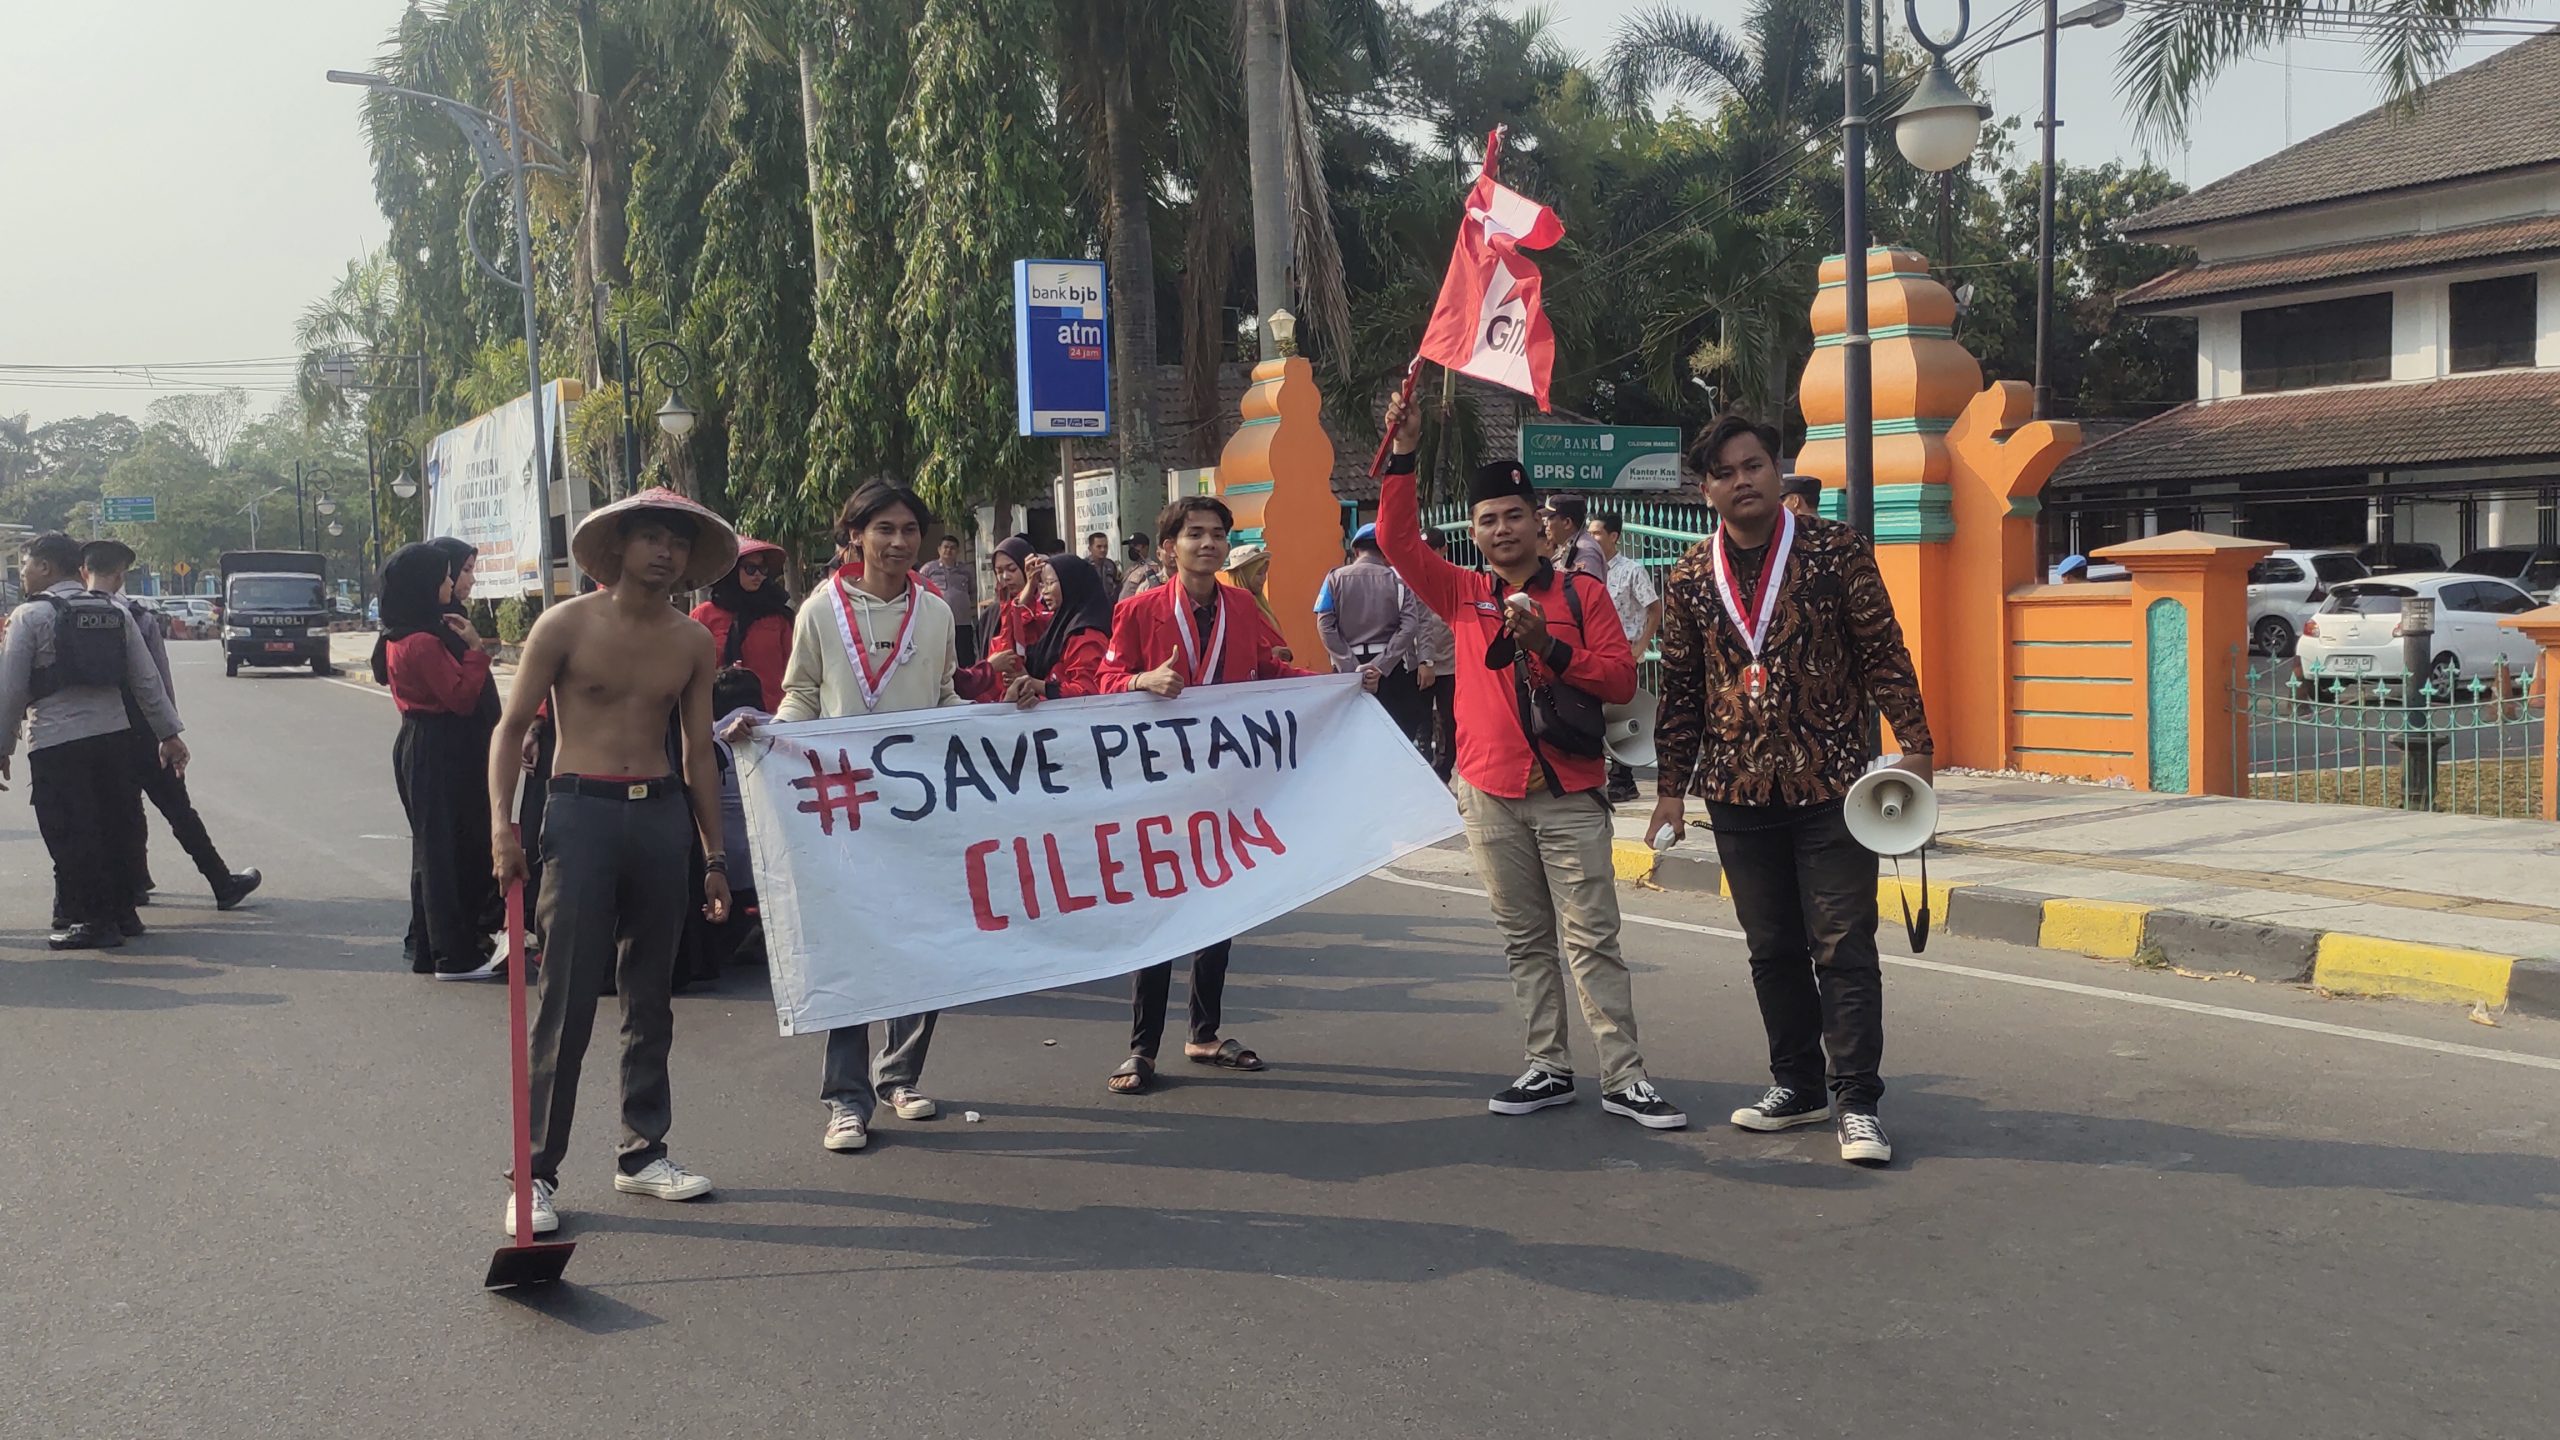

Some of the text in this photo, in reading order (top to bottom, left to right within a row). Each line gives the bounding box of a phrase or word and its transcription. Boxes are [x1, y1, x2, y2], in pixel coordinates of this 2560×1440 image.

[1032, 285, 1098, 304] bank bjb
[1057, 320, 1101, 345] atm
[1070, 348, 1099, 359] 24 jam
[1564, 438, 1599, 450] BANK
[1533, 464, 1603, 480] BPRS CM
[1629, 467, 1658, 476] Kantor
[252, 616, 305, 625] PATROLI
[788, 709, 1298, 836] #SAVE PETANI
[964, 807, 1287, 932] CILEGON
